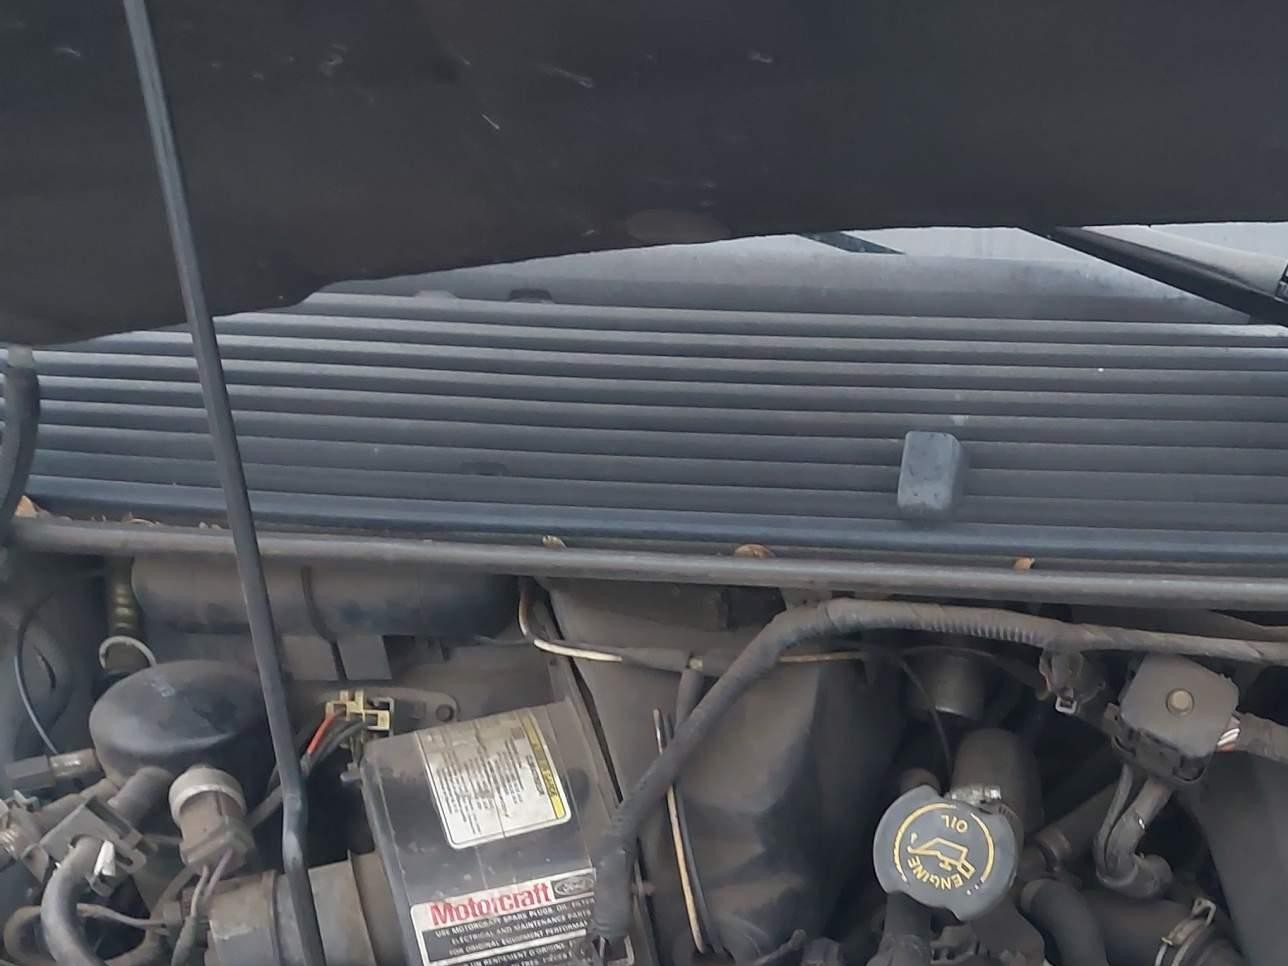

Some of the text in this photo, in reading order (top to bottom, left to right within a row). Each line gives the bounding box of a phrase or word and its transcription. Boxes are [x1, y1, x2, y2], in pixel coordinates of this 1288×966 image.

[940, 814, 968, 833] OIL
[907, 855, 965, 890] ENGINE
[430, 882, 550, 926] Motorcraft
